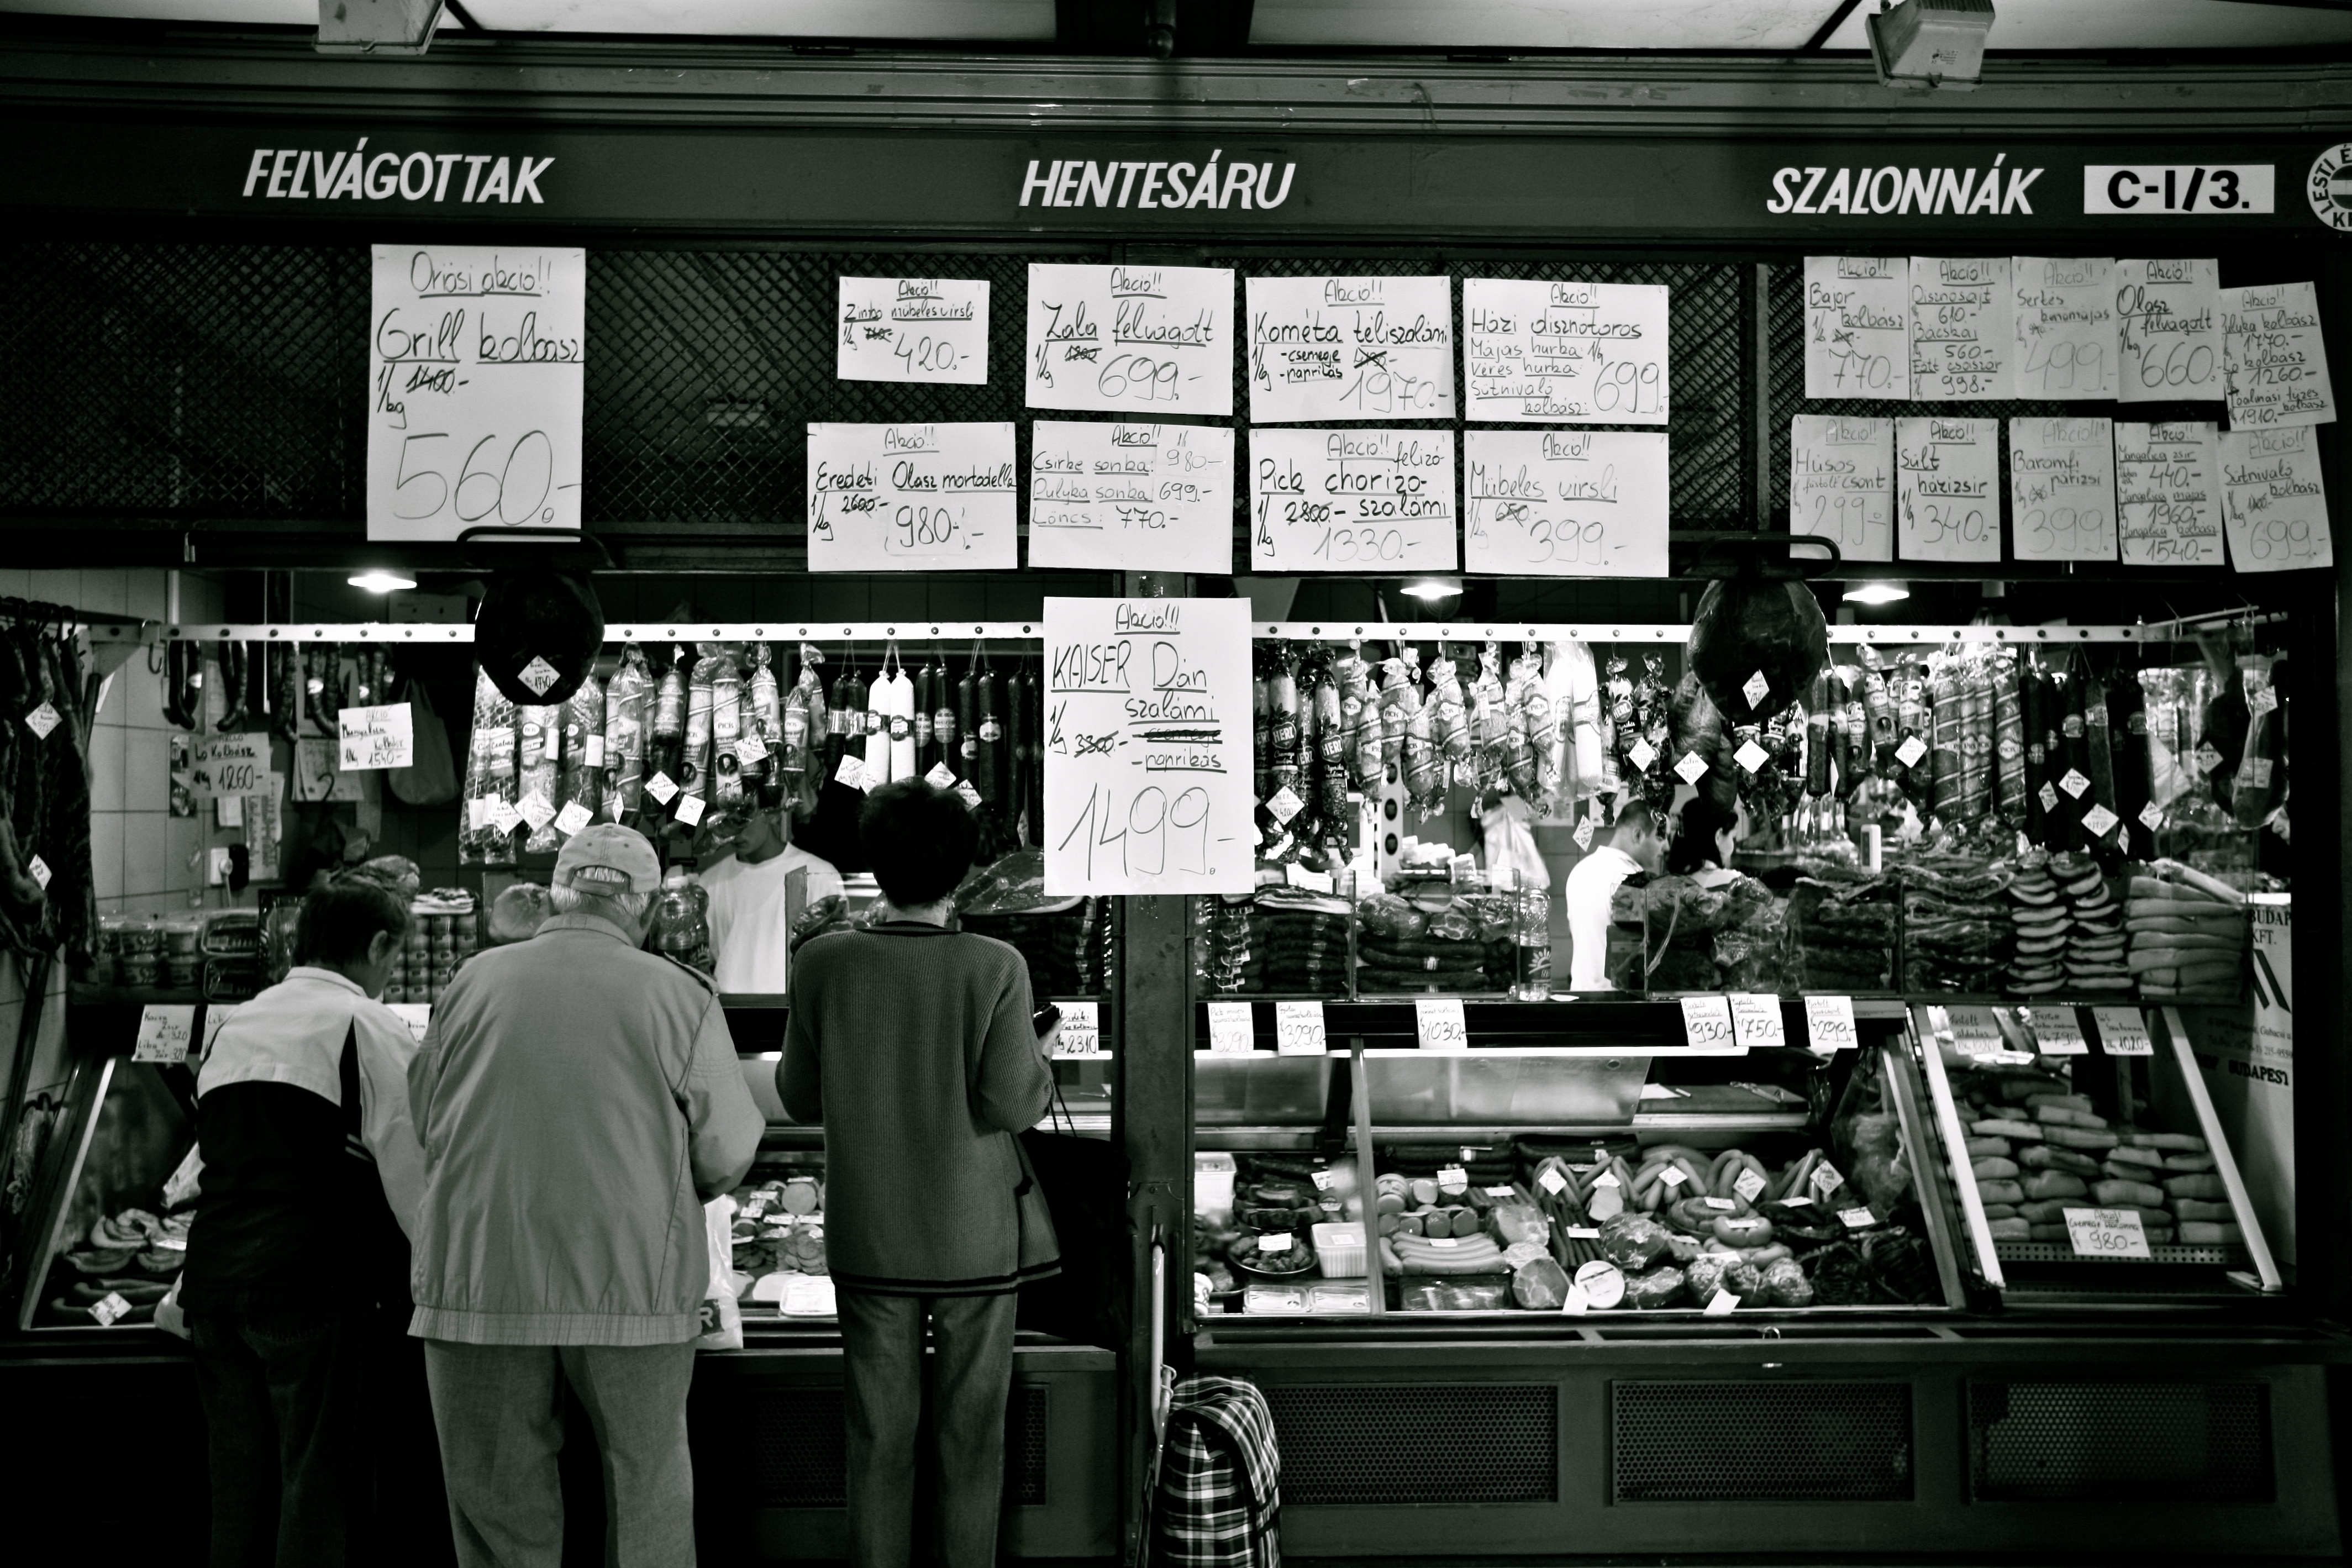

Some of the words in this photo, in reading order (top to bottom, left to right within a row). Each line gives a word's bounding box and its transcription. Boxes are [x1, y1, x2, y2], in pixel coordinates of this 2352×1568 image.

[243, 136, 555, 203] FELVÁGOTTAK
[1019, 149, 1296, 209] HENTESÁRU
[1767, 153, 2045, 214] SZALONNÁK
[1809, 283, 1855, 312] Bajor
[2117, 285, 2170, 315] Olasz
[377, 308, 464, 361] Grill
[1043, 301, 1097, 339] Zala
[1113, 300, 1214, 348] felvágott
[1254, 308, 1343, 343] Kométa
[1472, 308, 1516, 334] Házi
[894, 332, 969, 373] 420.-
[1099, 354, 1203, 401] 699.-
[393, 429, 581, 525] 560.-
[816, 462, 877, 490] Eredeti
[892, 462, 937, 488] Olasz
[944, 464, 1017, 491] mortadella
[1033, 451, 1083, 472] Csirke
[1260, 459, 1304, 493] Pick
[2013, 451, 2080, 474] Baromfi
[1033, 478, 1090, 500] Pulyka
[1559, 464, 1617, 499] virsli
[1358, 492, 1448, 518] szalámi
[1053, 640, 1131, 688] KAISER
[1153, 641, 1207, 688] Dán
[1124, 688, 1214, 721] szalámi
[1058, 782, 1236, 881] 1499.-
